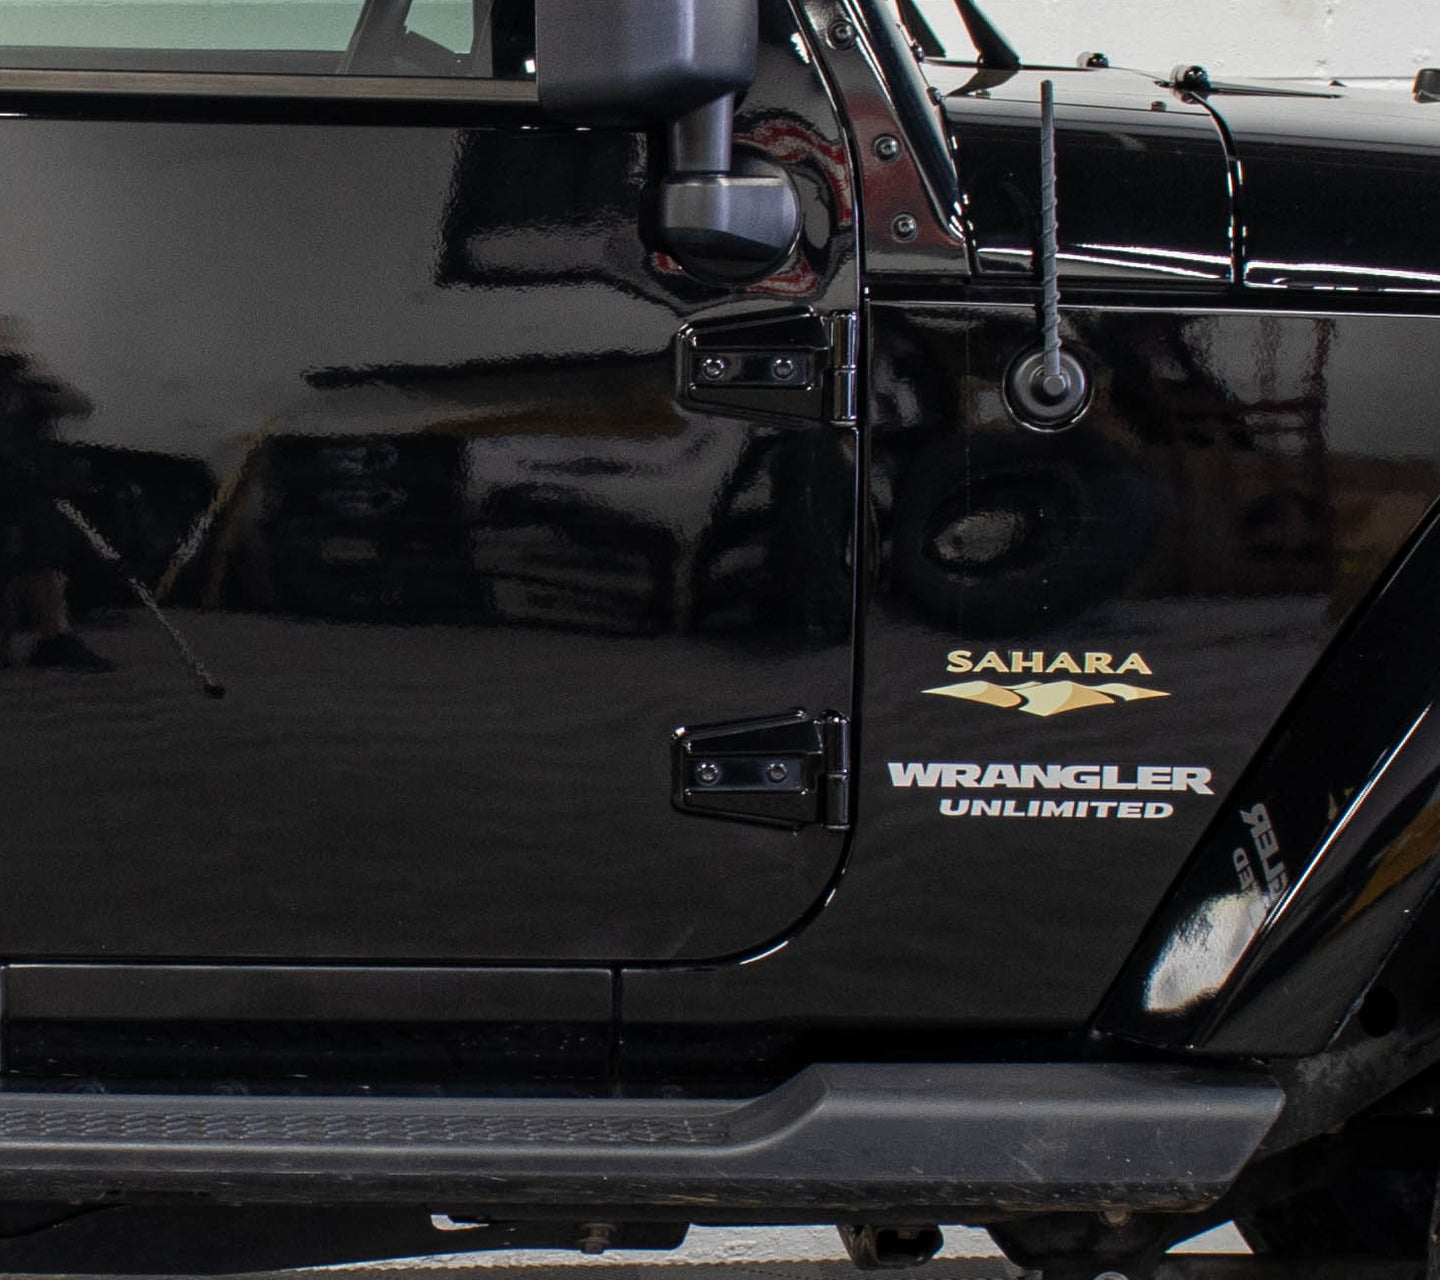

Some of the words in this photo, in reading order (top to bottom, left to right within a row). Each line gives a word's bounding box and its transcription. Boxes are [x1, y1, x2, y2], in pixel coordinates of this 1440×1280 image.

[946, 650, 1153, 675] SAHARA
[887, 762, 1215, 795] WRANGLER
[939, 799, 1175, 819] UNLIMITED
